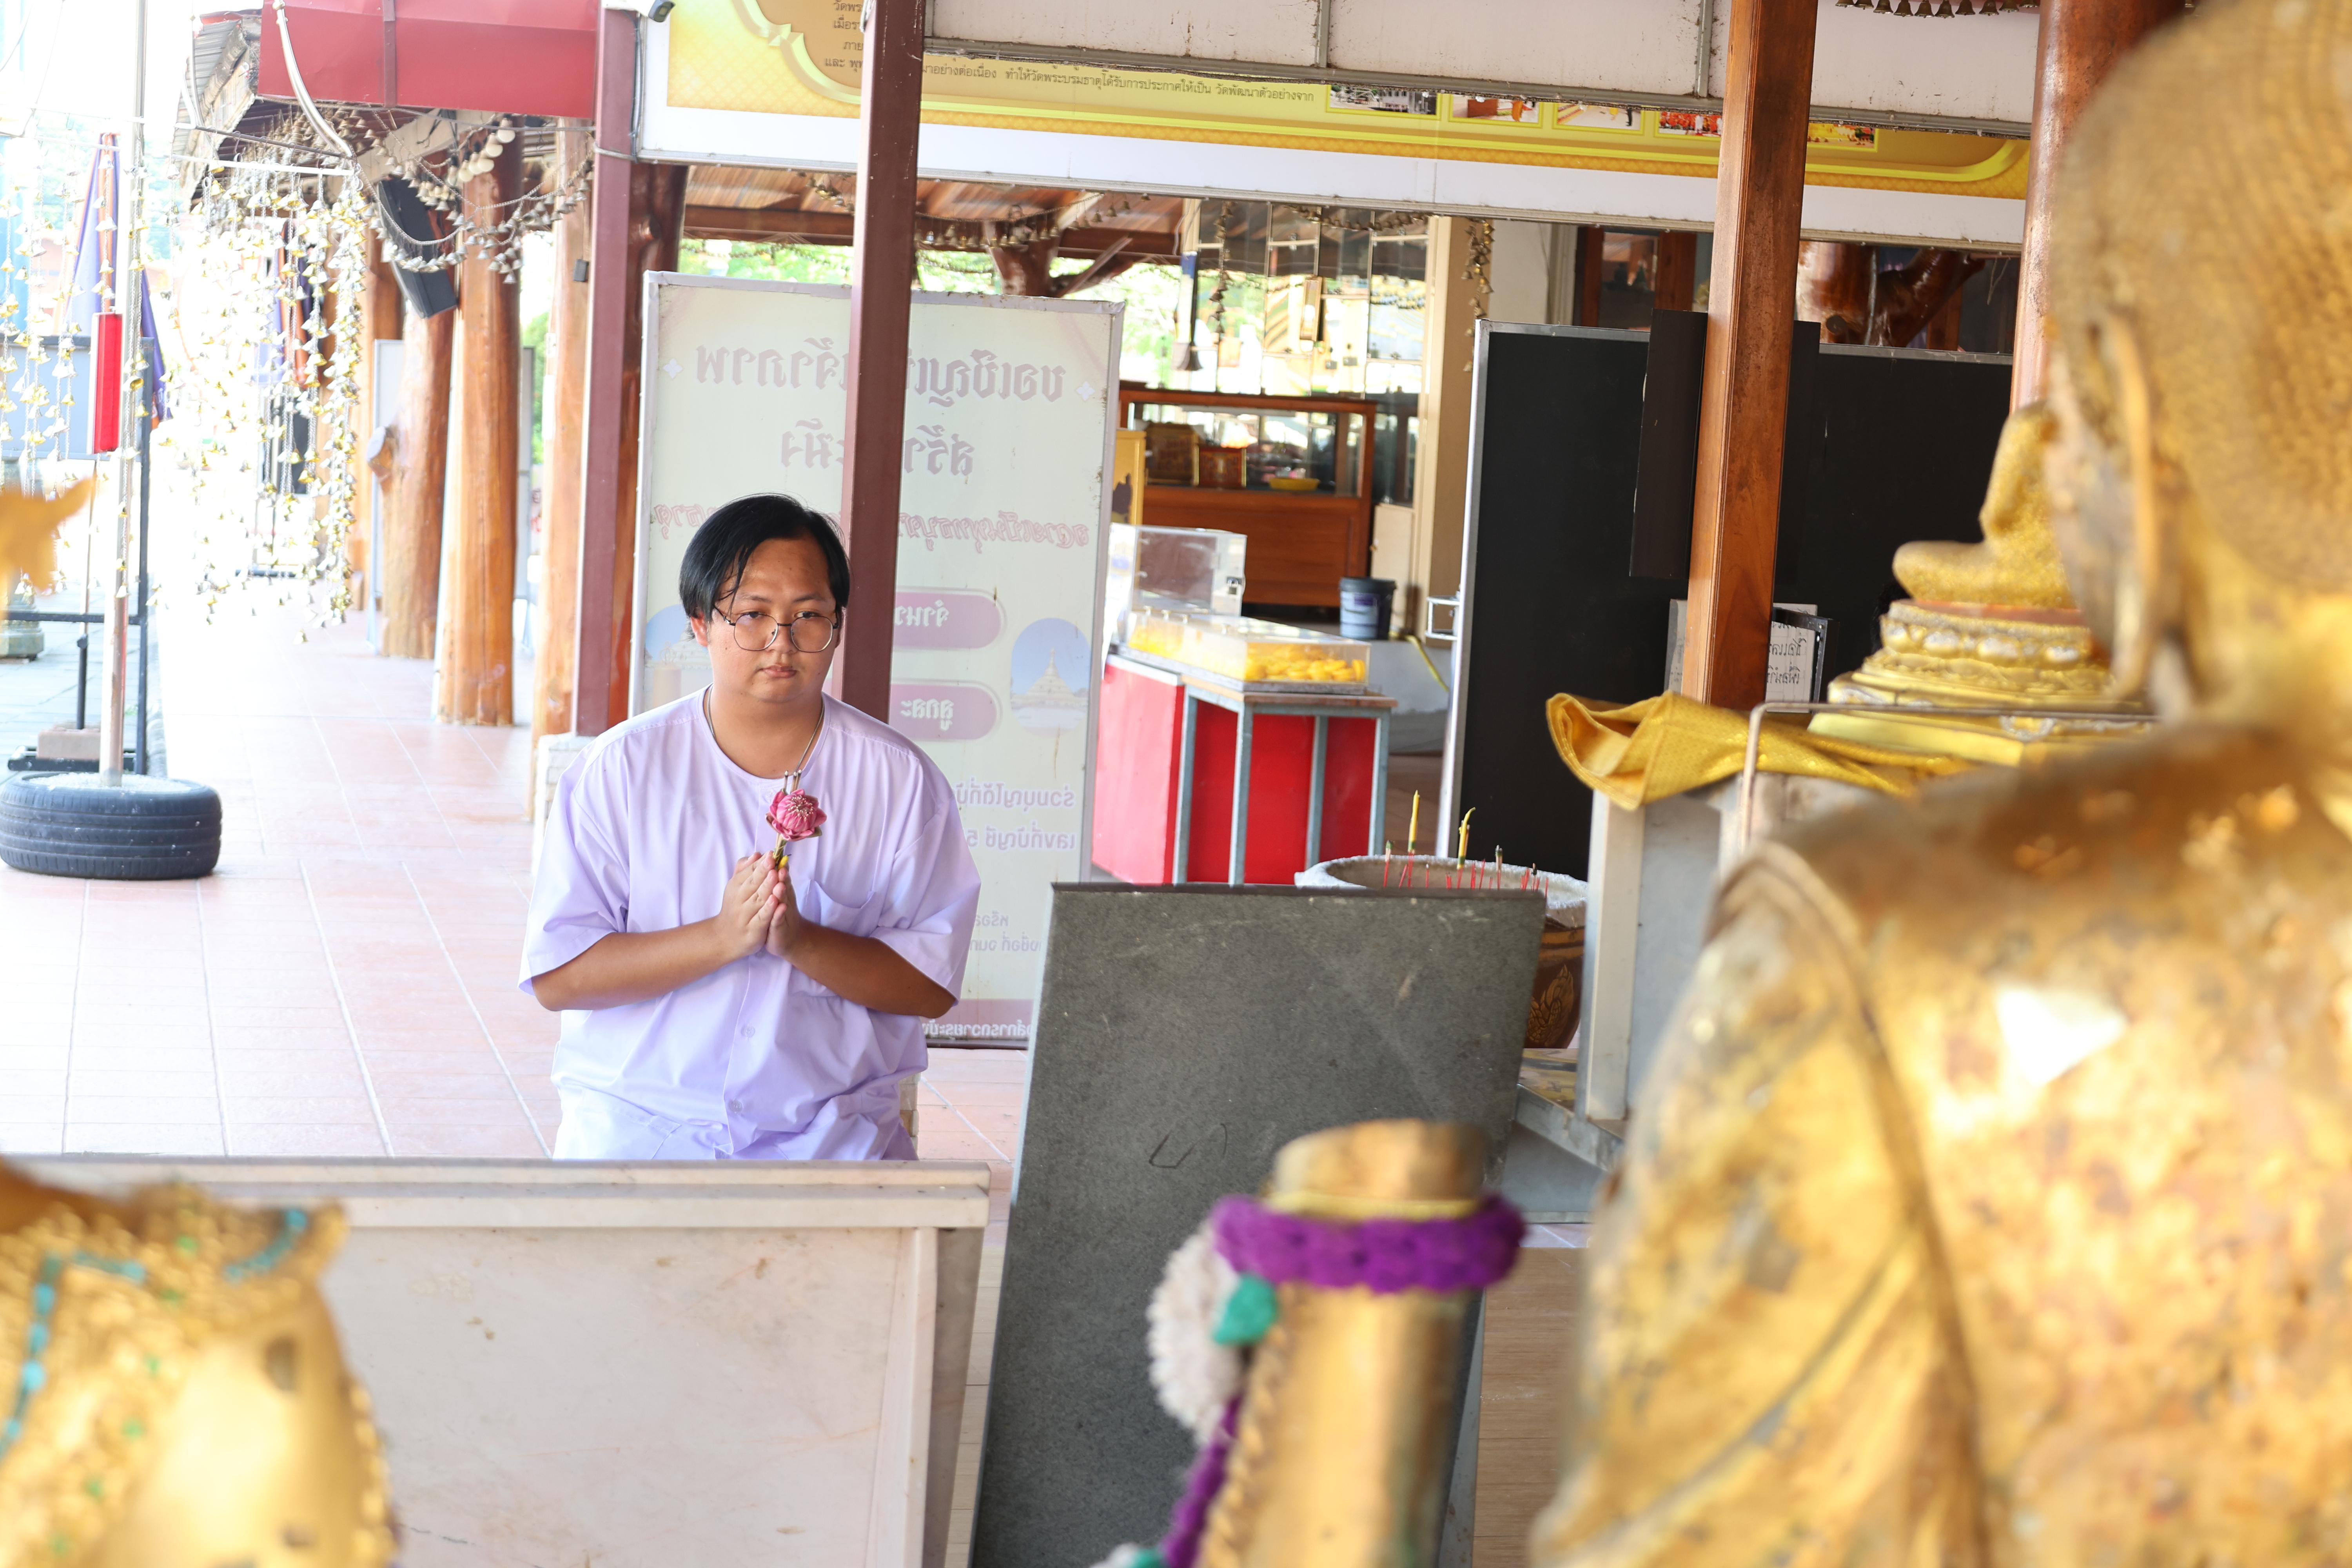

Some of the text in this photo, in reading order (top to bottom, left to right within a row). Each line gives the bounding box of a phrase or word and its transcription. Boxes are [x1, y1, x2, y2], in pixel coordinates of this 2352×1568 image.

[834, 15, 860, 29] เมื่อร
[825, 58, 845, 67] และ
